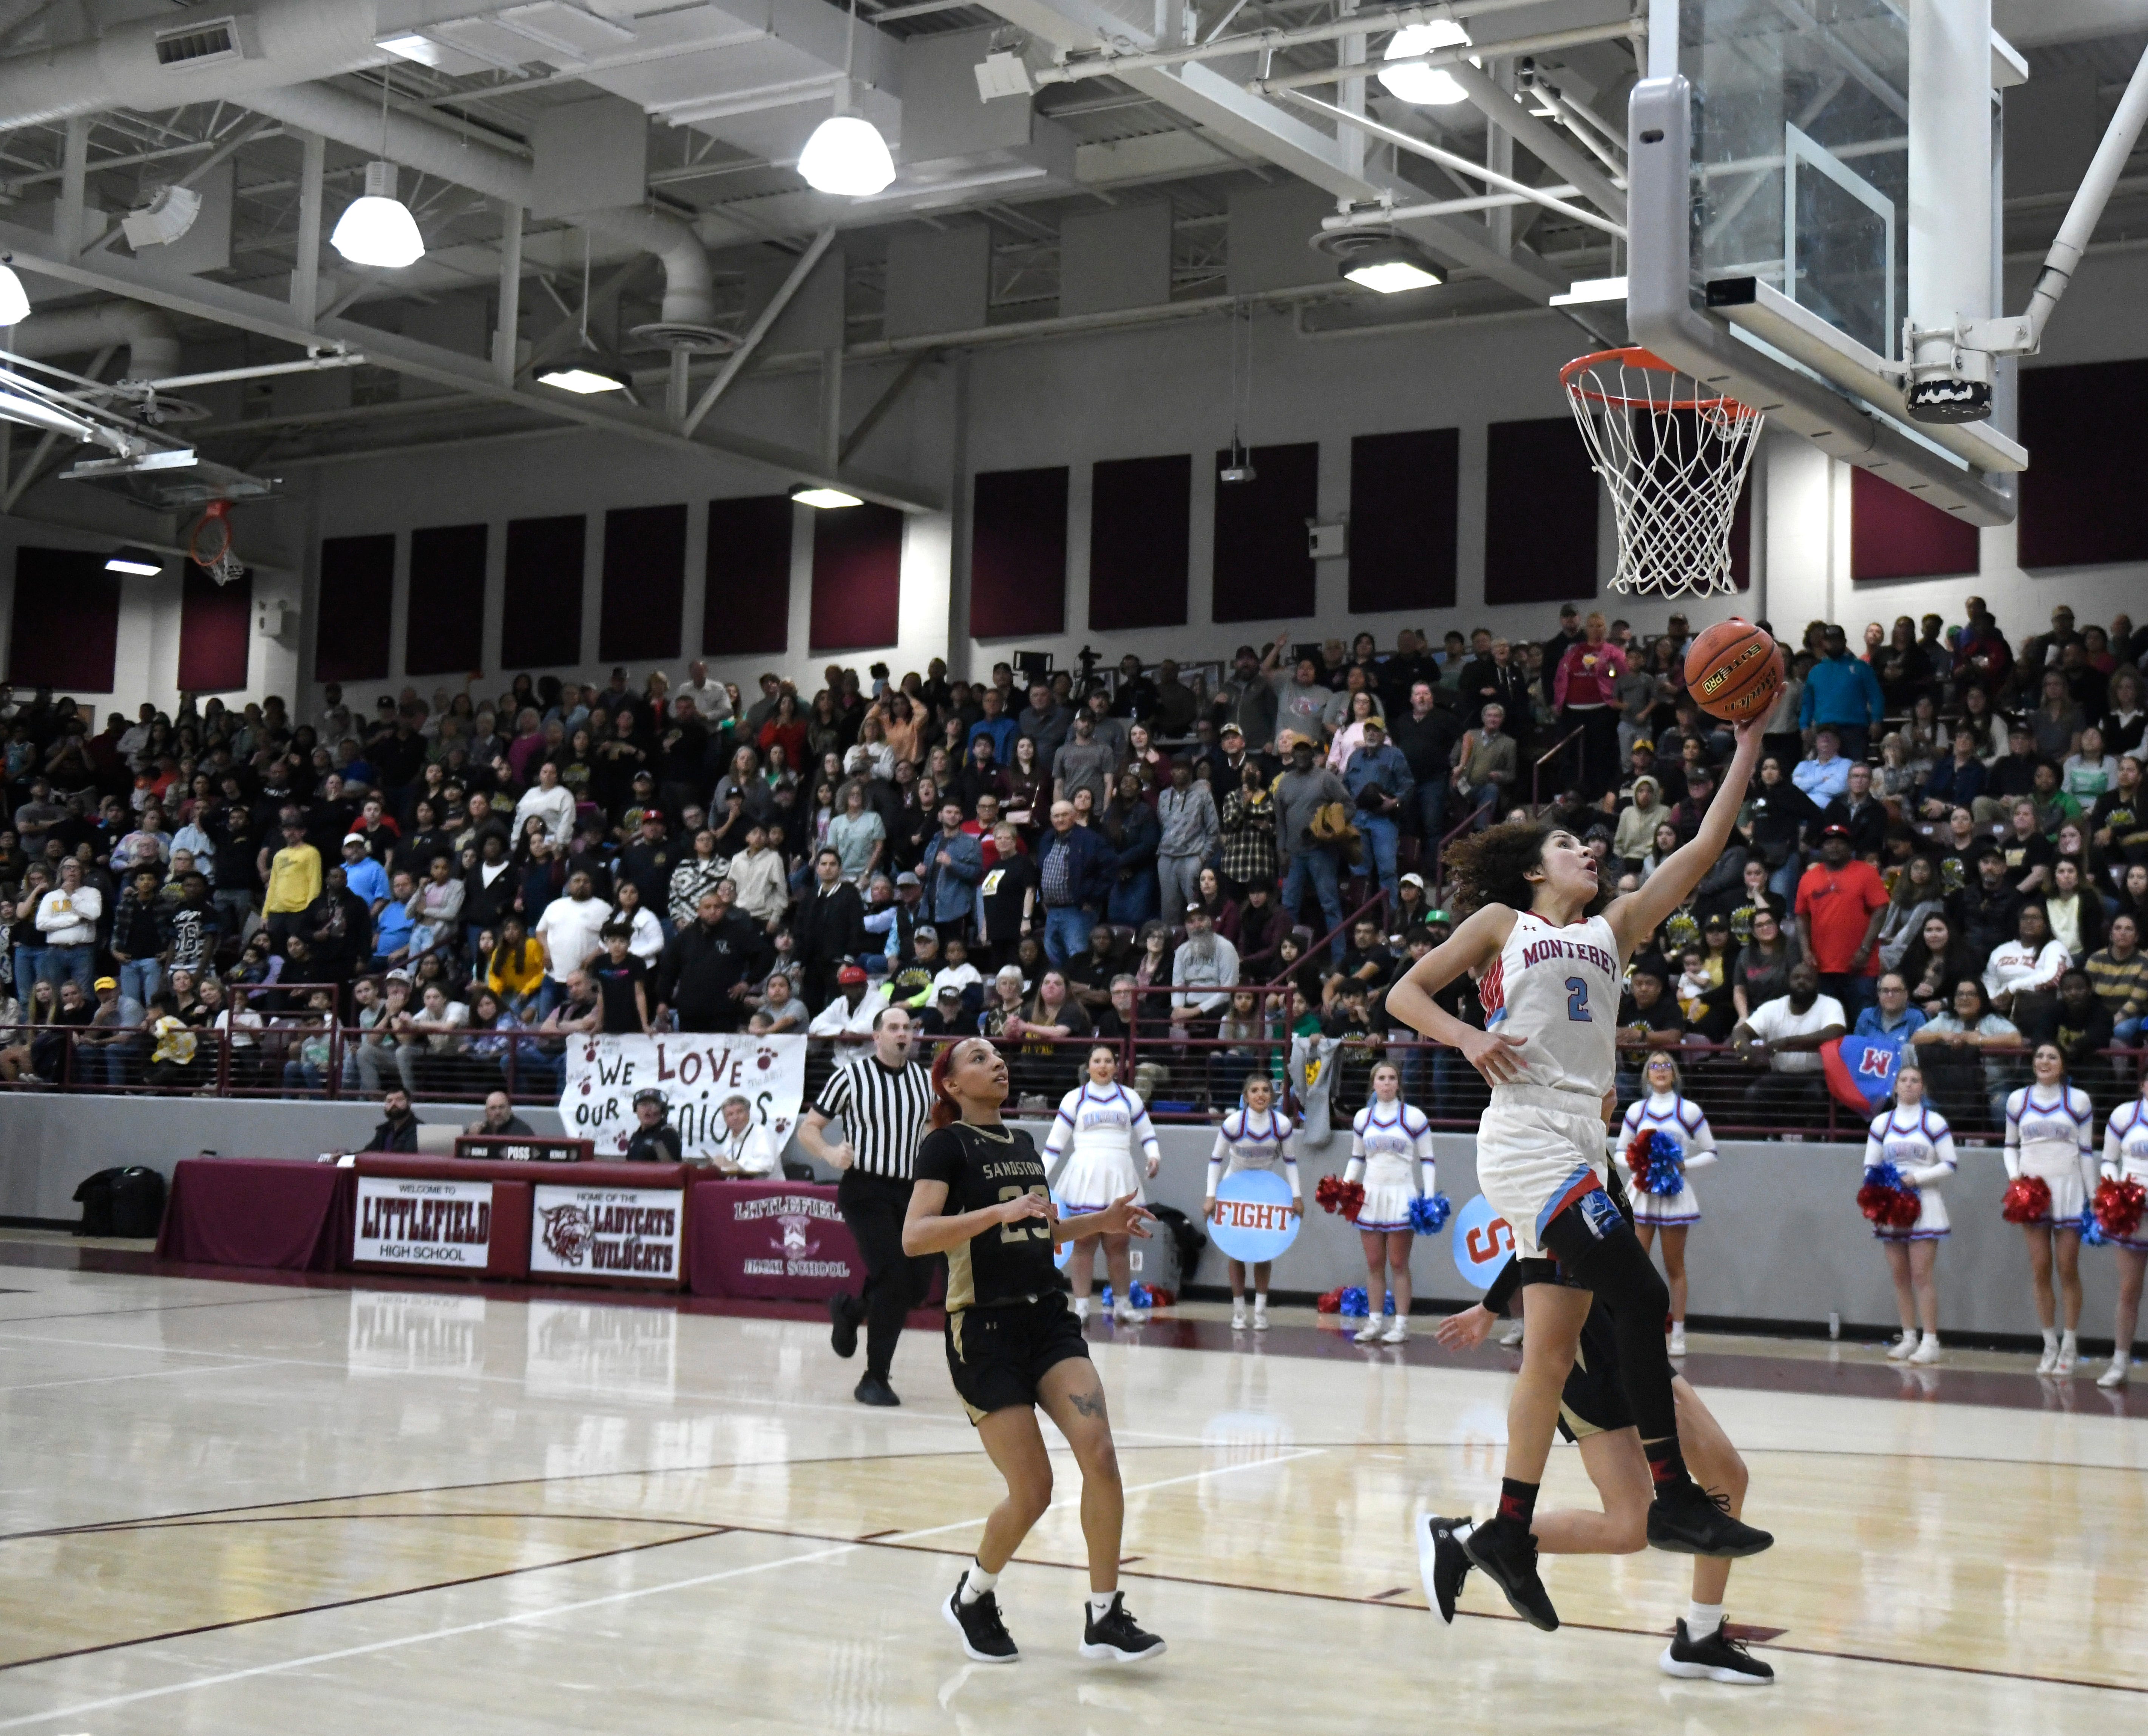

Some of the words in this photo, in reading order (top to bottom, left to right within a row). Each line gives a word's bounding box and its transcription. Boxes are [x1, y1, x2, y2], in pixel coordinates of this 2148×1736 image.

[1721, 643, 1762, 678] ELITE
[1703, 674, 1723, 693] PRO
[1522, 939, 1617, 982] MONTEREY
[1565, 976, 1592, 1022] 2
[598, 1054, 635, 1086] WE
[657, 1043, 743, 1088] LOVE
[575, 1097, 619, 1126] OUR
[399, 1184, 442, 1194] WELCOME
[445, 1186, 456, 1195] TO
[576, 1191, 603, 1202] HOME
[605, 1193, 618, 1202] OF
[620, 1194, 637, 1203] THE
[361, 1196, 491, 1245] LITTLEFIELD
[593, 1205, 675, 1237] LADYCATS
[1214, 1201, 1294, 1231] FIGHT
[380, 1244, 410, 1258] HIGH
[414, 1247, 465, 1262] SCHOOL
[592, 1241, 673, 1272] WILDCATS
[744, 1259, 784, 1275] HIGH
[787, 1259, 850, 1278] SCHOOL
